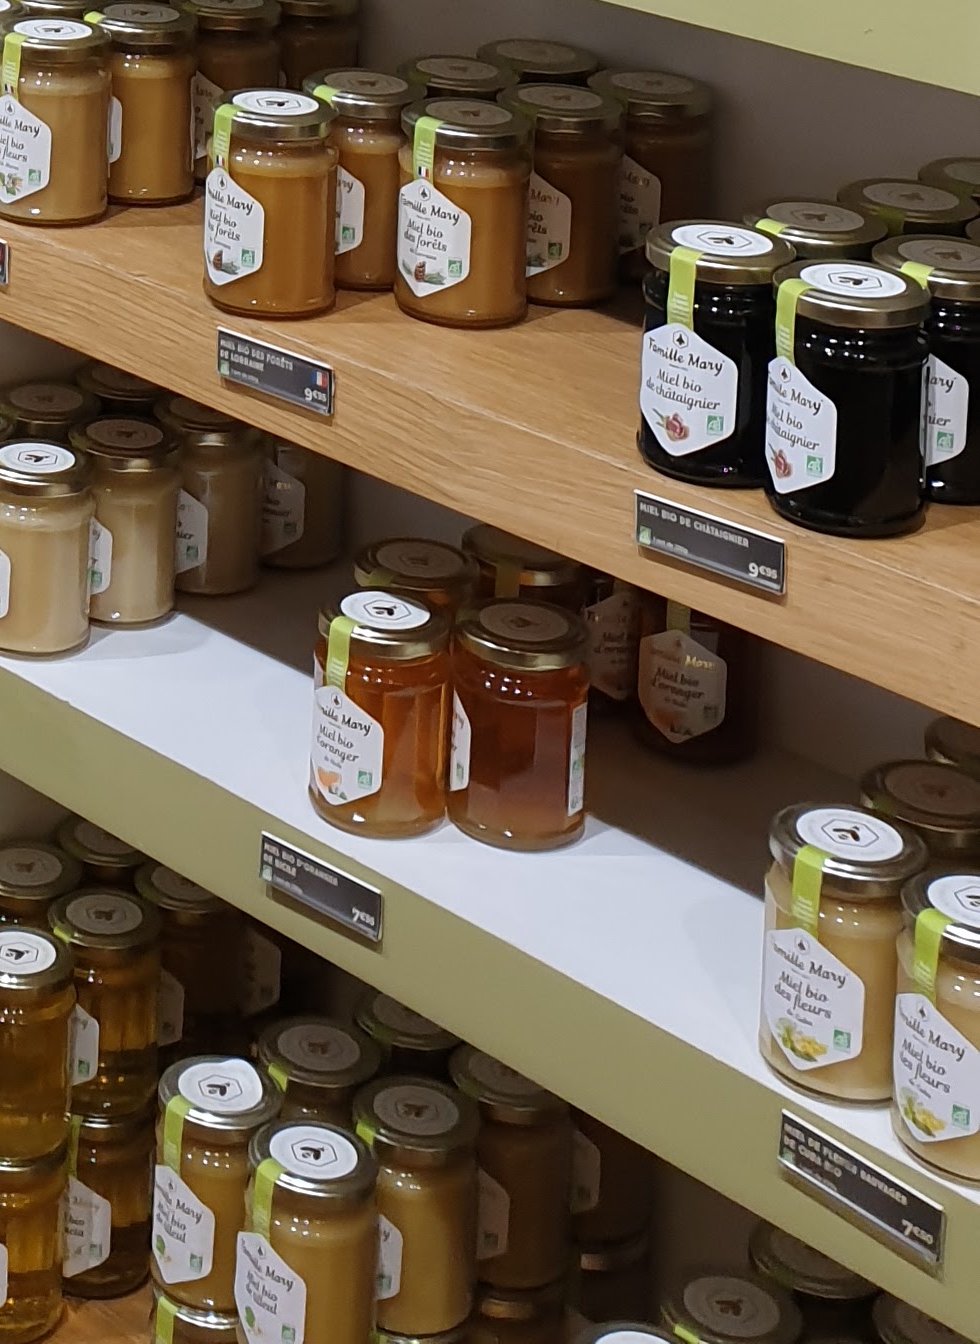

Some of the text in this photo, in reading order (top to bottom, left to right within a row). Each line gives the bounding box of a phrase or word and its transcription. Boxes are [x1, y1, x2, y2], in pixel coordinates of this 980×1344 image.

[430, 205, 461, 224] Mary
[417, 232, 447, 253] forêts
[426, 225, 444, 238] bio
[648, 336, 724, 376] Famille Mary
[656, 369, 701, 393] Miel bio
[655, 385, 720, 410] châtaignier
[790, 389, 824, 415] Mary
[787, 413, 803, 430] bio
[661, 508, 677, 522] BIO
[679, 514, 691, 527] DE
[693, 518, 749, 548] CHÂTAIGNIER
[341, 713, 373, 735] Mary
[337, 734, 354, 749] bio
[780, 972, 828, 1005] Miel bio
[808, 963, 847, 991] Mary
[793, 991, 832, 1020] fleurs
[928, 1030, 965, 1063] Mary
[915, 1060, 950, 1095] fleurs
[924, 1054, 947, 1077] bio
[175, 1199, 203, 1223] Mary
